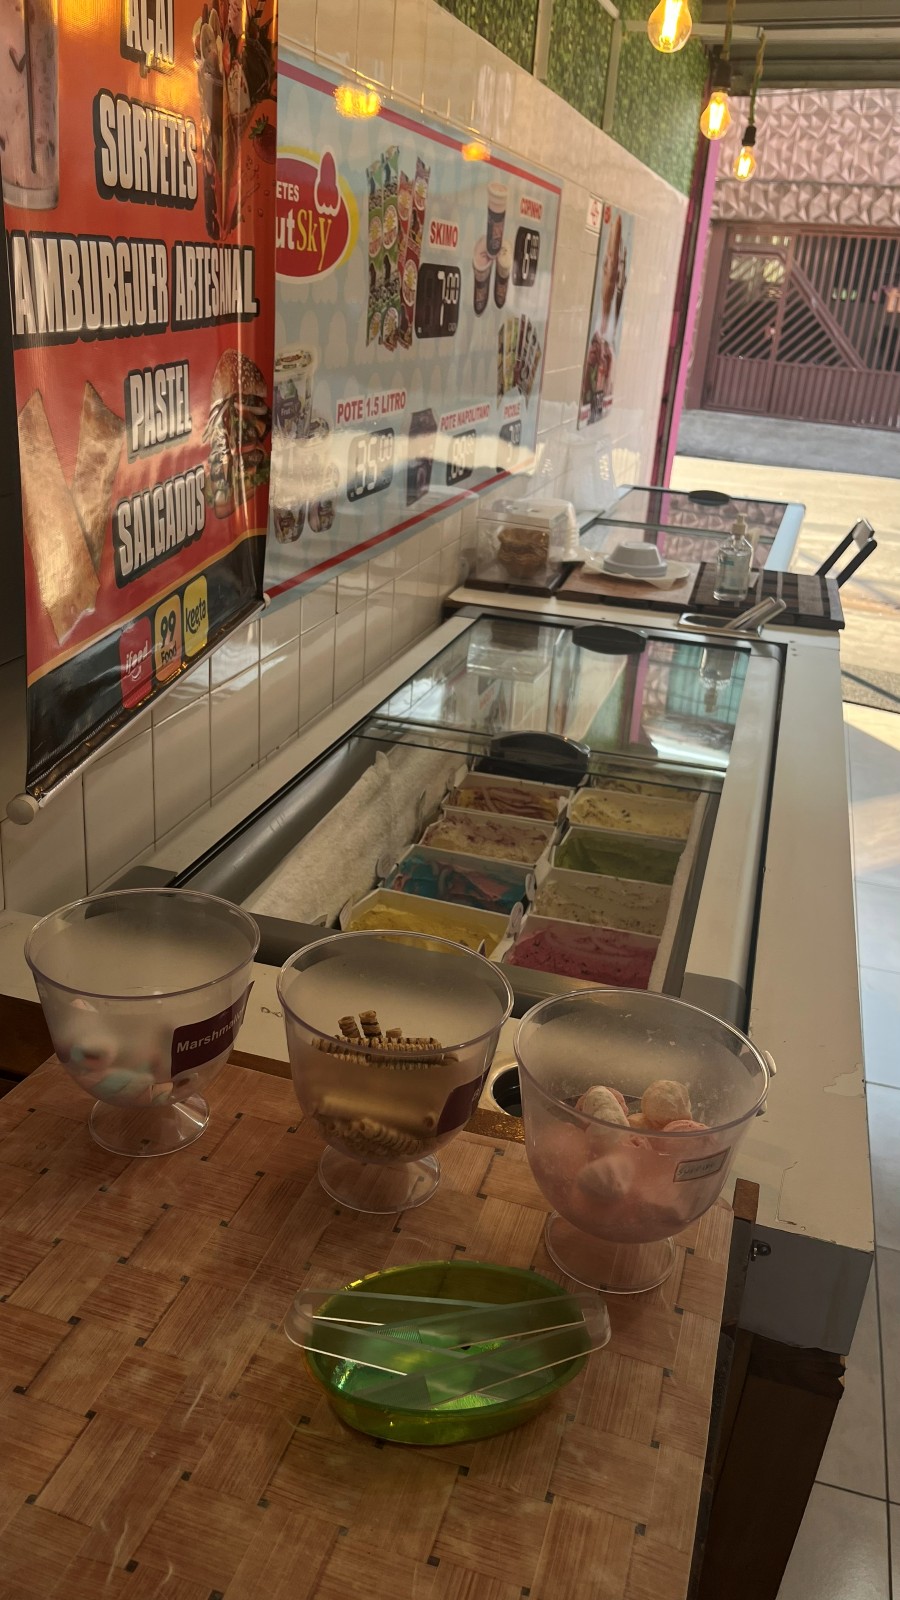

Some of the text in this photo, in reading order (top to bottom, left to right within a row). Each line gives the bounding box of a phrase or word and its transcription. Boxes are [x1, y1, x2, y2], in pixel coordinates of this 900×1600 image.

[100, 94, 198, 200] SORVETES
[276, 181, 300, 203] ETES
[276, 208, 332, 271] utSky
[8, 236, 257, 335] AMBURGUER ARTESANAL
[129, 363, 192, 452] PASTEL
[337, 400, 363, 424] POTE
[381, 391, 406, 413] LITRO
[117, 466, 205, 577] SALGADOS
[161, 610, 176, 648] 99
[186, 598, 206, 634] keeta
[161, 641, 177, 663] Food
